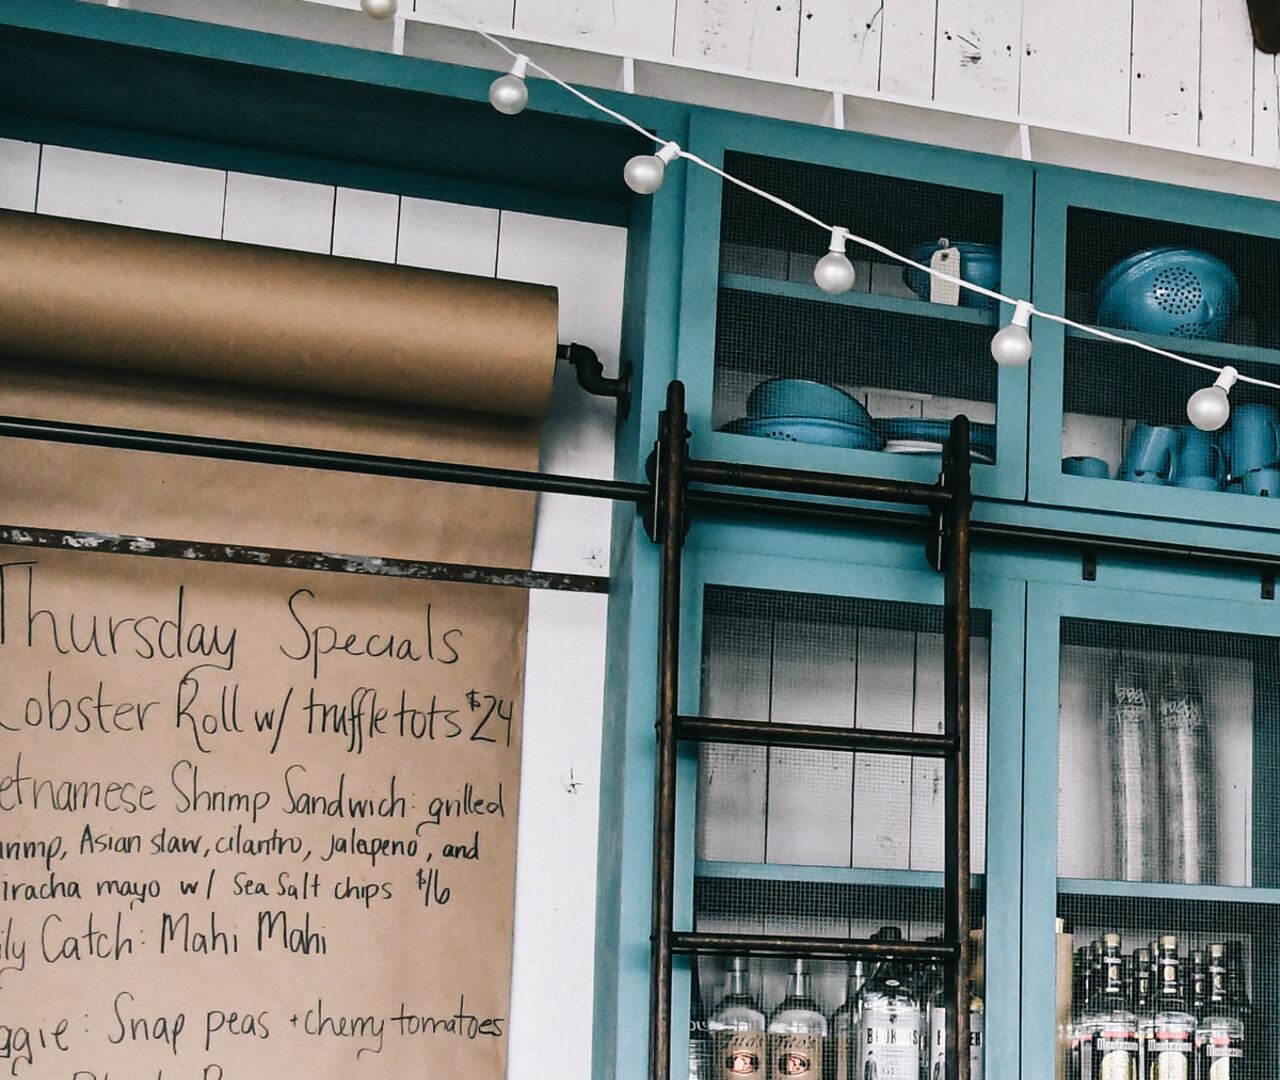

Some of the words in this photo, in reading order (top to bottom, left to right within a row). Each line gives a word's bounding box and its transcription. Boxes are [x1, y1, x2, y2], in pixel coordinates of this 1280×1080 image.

[280, 588, 464, 679] Specials
[0, 671, 160, 732] obster
[175, 678, 246, 753] Roll
[255, 687, 294, 753] w/
[302, 687, 387, 753] truffle
[393, 694, 462, 741] tots
[465, 688, 516, 747] $24
[171, 759, 271, 821] Shrimp
[416, 782, 505, 836] grilled
[80, 825, 142, 855] Asian
[150, 826, 210, 860] slaw,
[214, 827, 313, 863] cilantro,
[443, 831, 480, 861] and
[96, 881, 161, 912] mayo
[180, 868, 216, 901] w/
[233, 872, 268, 899] Sea
[276, 870, 320, 899] Salt
[333, 876, 393, 908] chips
[416, 869, 451, 906] $16
[160, 913, 239, 955] Mahi
[256, 910, 327, 955] Mahi
[108, 991, 184, 1055] Snap
[206, 1005, 269, 1050] peas
[390, 994, 505, 1038] tomatoes
